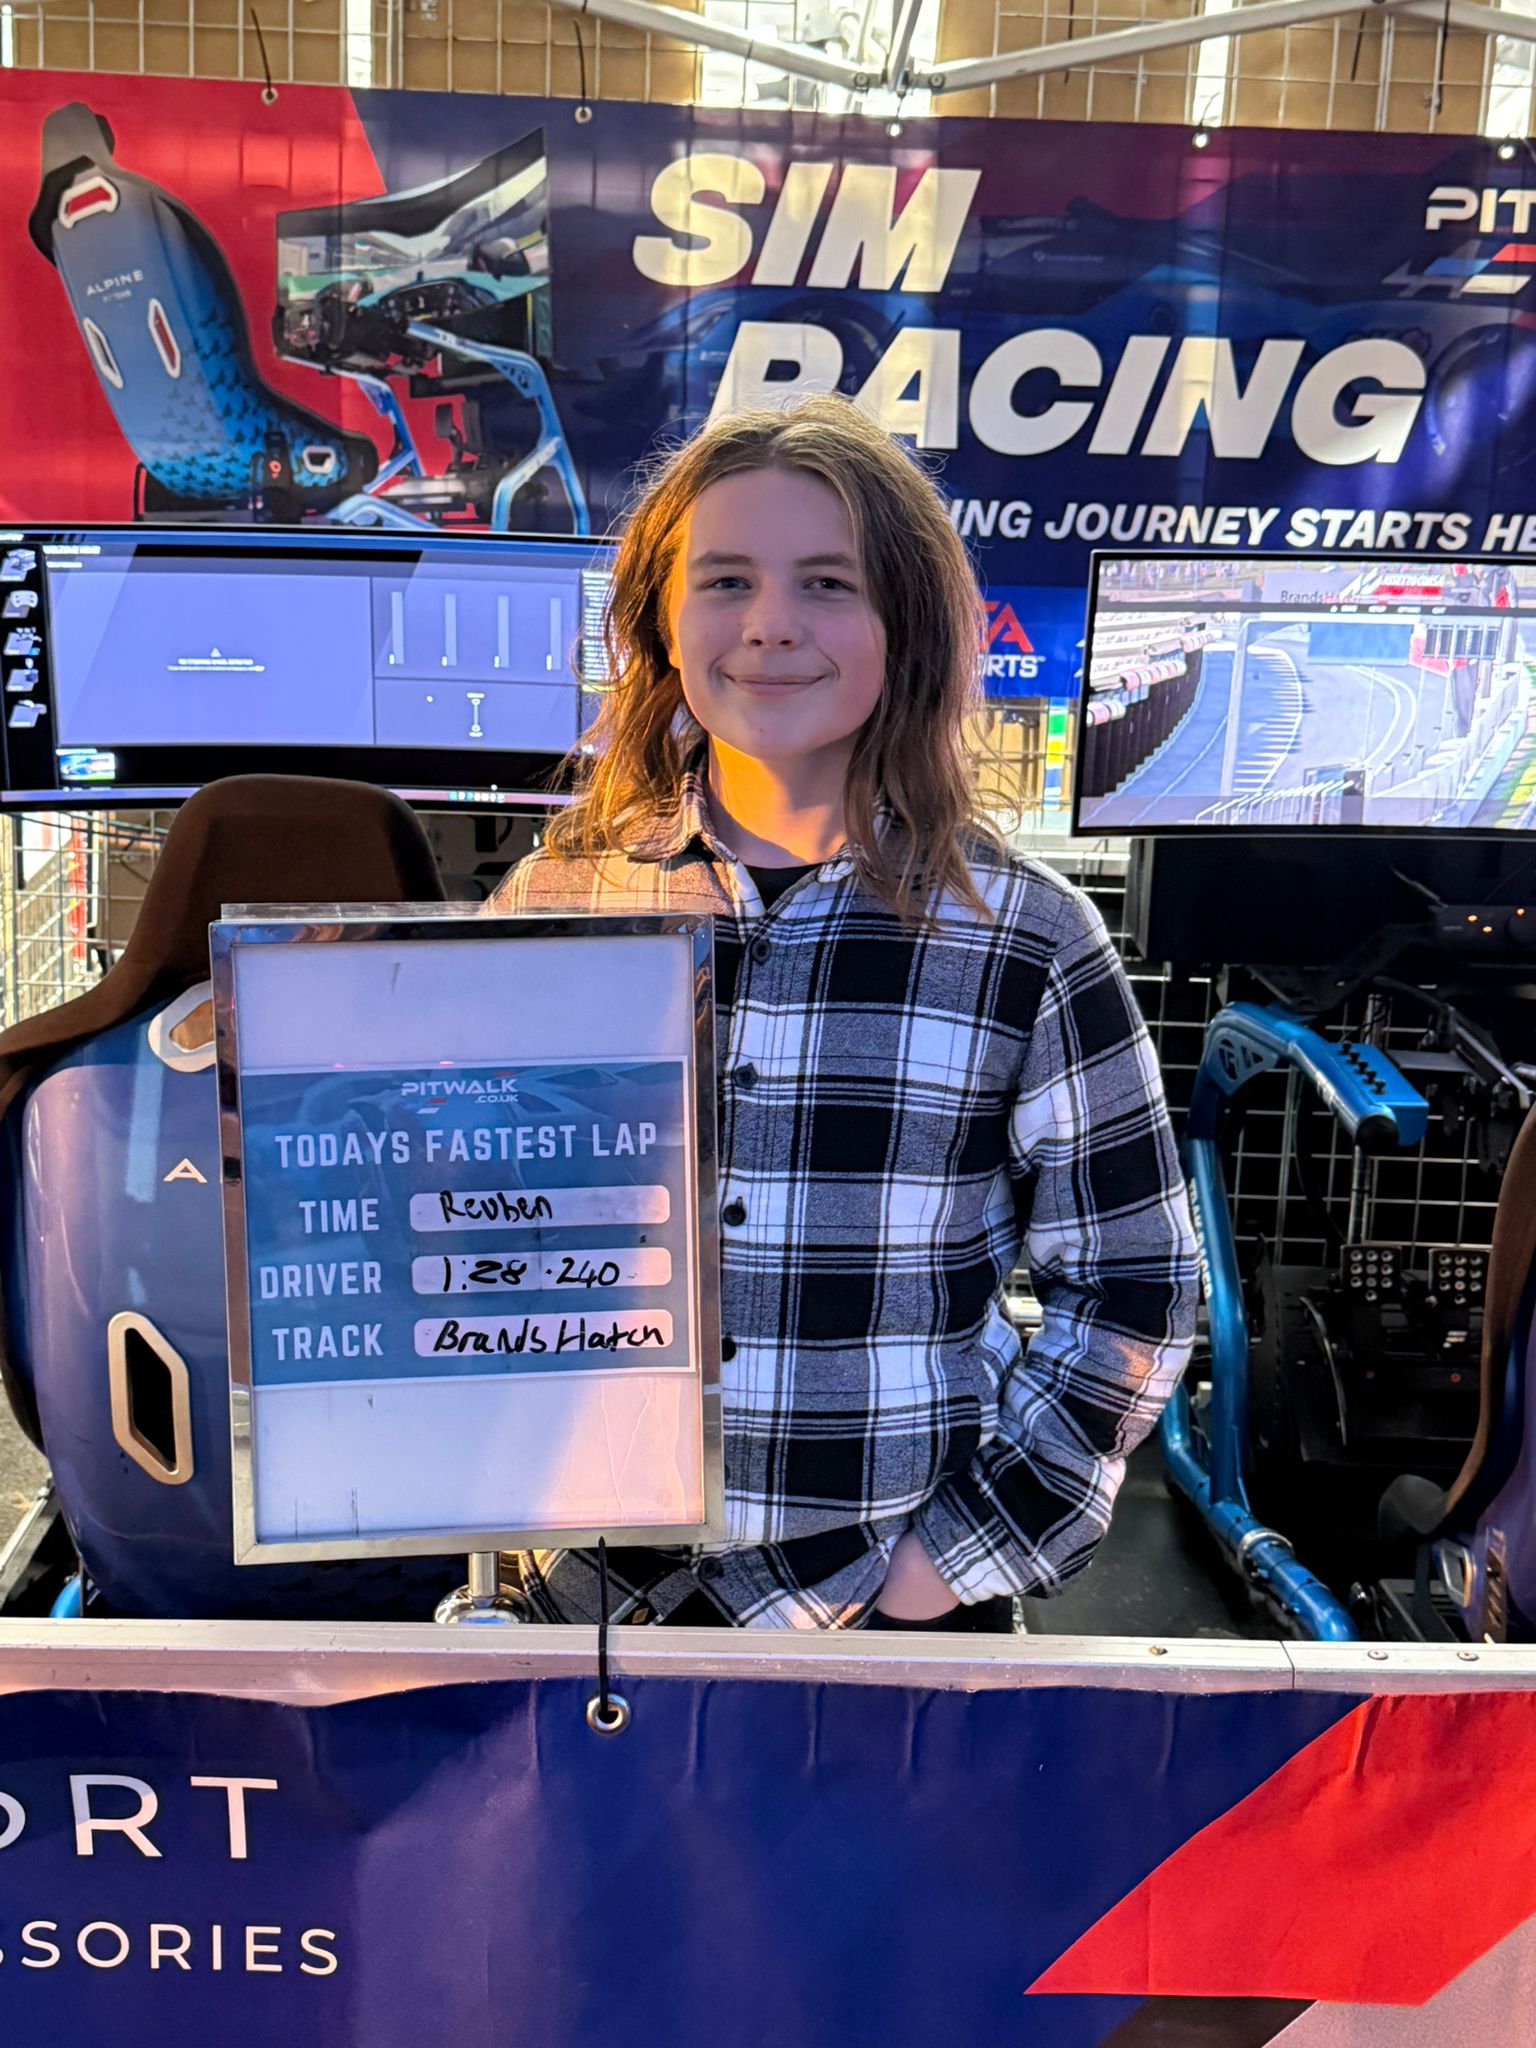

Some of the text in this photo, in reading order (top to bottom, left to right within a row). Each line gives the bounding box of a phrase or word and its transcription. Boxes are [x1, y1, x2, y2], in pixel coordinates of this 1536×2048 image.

[632, 153, 981, 293] SIM
[86, 270, 144, 296] ALPINE
[705, 321, 1427, 464] RACING
[1044, 502, 1281, 546] JOURNEY
[1285, 508, 1472, 551] STARTS
[401, 1078, 518, 1096] PITWALK
[275, 1122, 657, 1168] TODAYS FASTEST LAP
[299, 1198, 380, 1234] TIME
[440, 1190, 553, 1223] Reuben
[260, 1261, 382, 1299] DRIVER
[272, 1323, 384, 1361] TRACK
[0, 1774, 278, 1859] RT
[0, 1920, 338, 1976] SORIES
